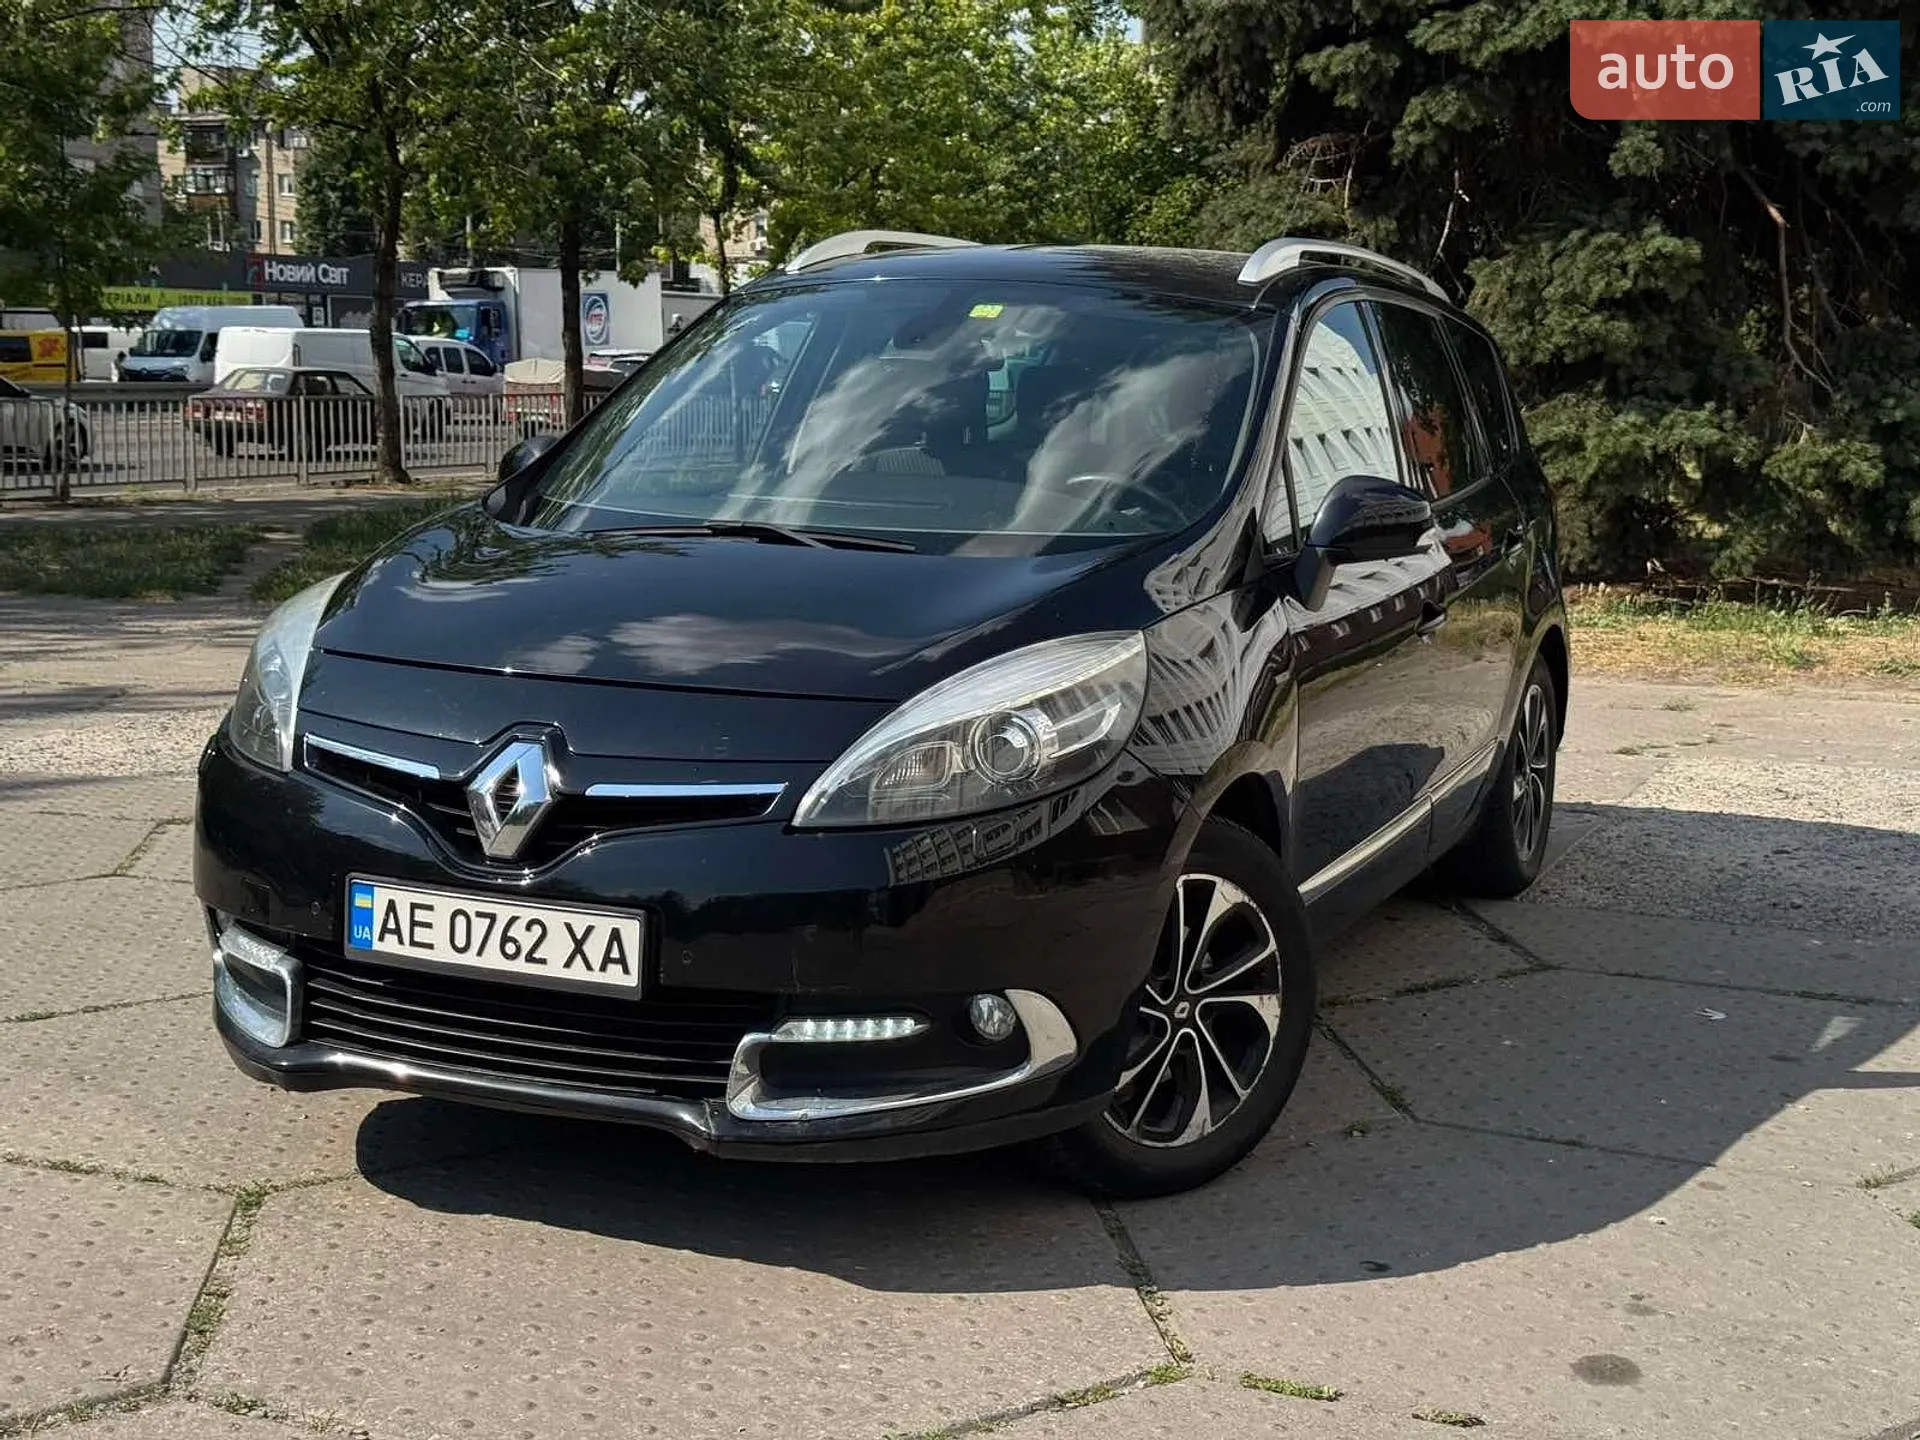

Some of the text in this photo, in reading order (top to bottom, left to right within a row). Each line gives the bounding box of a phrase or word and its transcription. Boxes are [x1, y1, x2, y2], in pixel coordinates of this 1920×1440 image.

[353, 923, 372, 941] UA
[377, 898, 632, 976] AE 0762 XA
